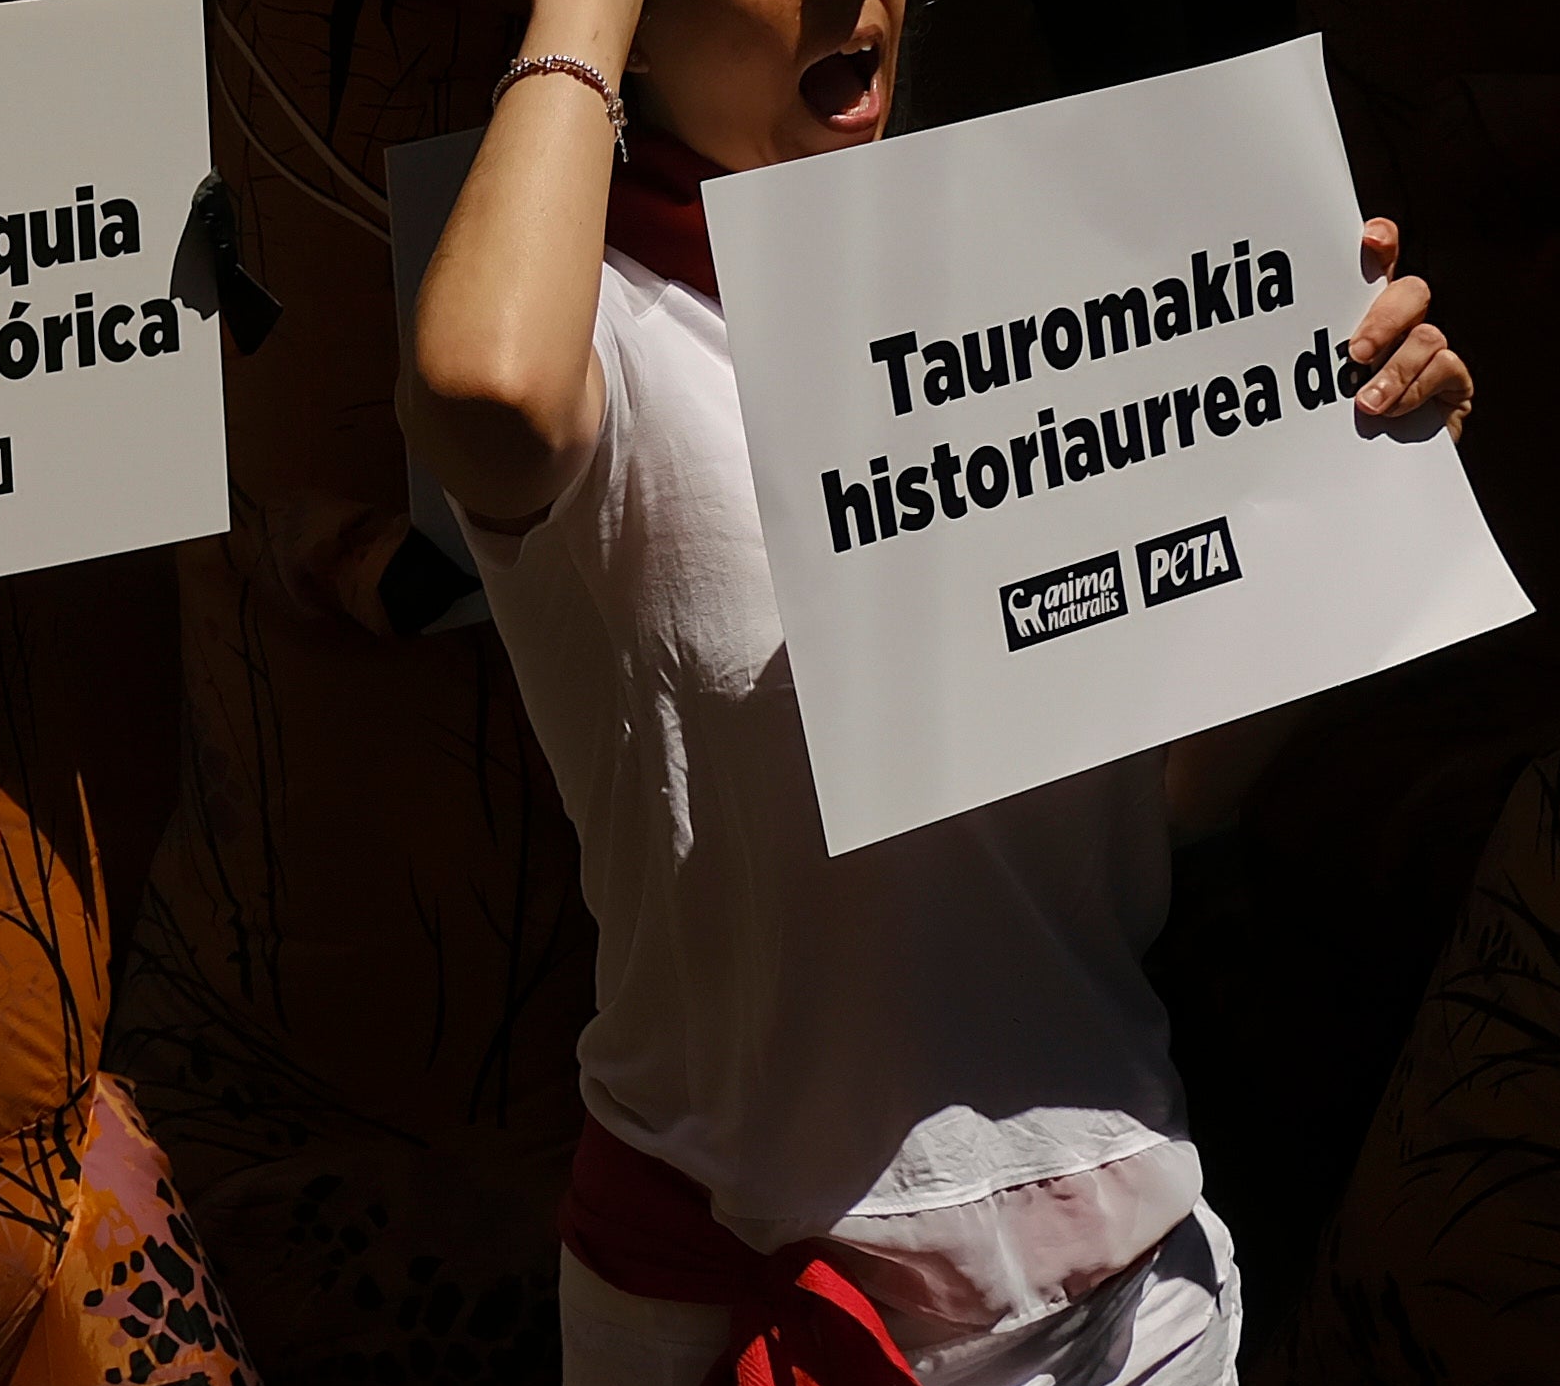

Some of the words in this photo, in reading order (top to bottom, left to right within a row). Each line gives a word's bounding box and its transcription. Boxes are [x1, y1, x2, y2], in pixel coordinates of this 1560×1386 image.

[870, 239, 1294, 417] Tauromakia
[821, 363, 1281, 554] historiaurrea
[1043, 565, 1115, 608] anima
[1046, 589, 1121, 633] naturalis
